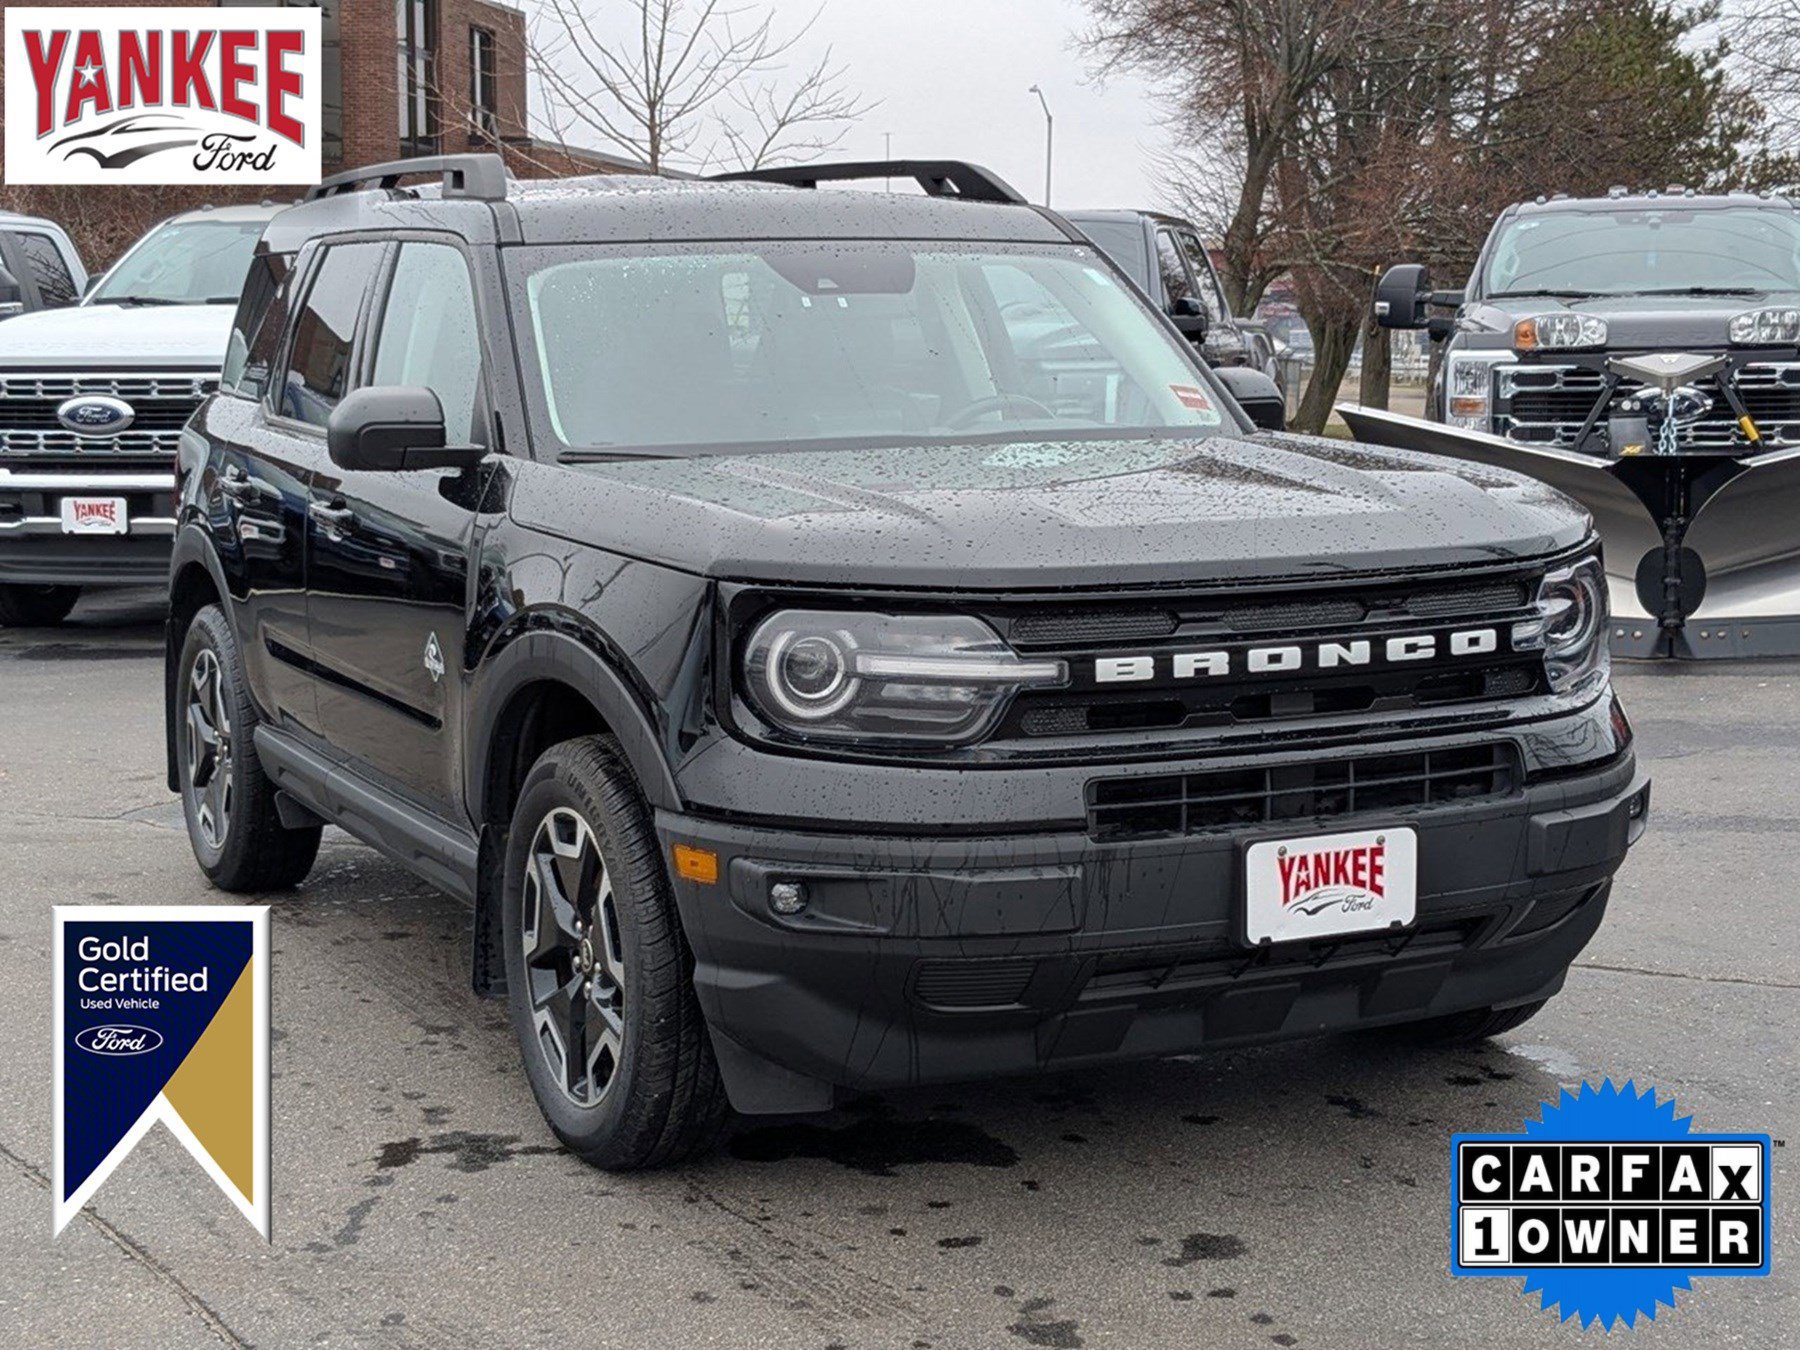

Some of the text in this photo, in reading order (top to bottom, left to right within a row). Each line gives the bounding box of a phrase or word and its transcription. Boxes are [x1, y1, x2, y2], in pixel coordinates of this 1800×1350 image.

[76, 405, 111, 424] Ford
[73, 500, 116, 522] YANKEE
[1095, 629, 1497, 682] BRONCO
[1277, 846, 1385, 906] YANKEE
[1341, 893, 1374, 913] Ford
